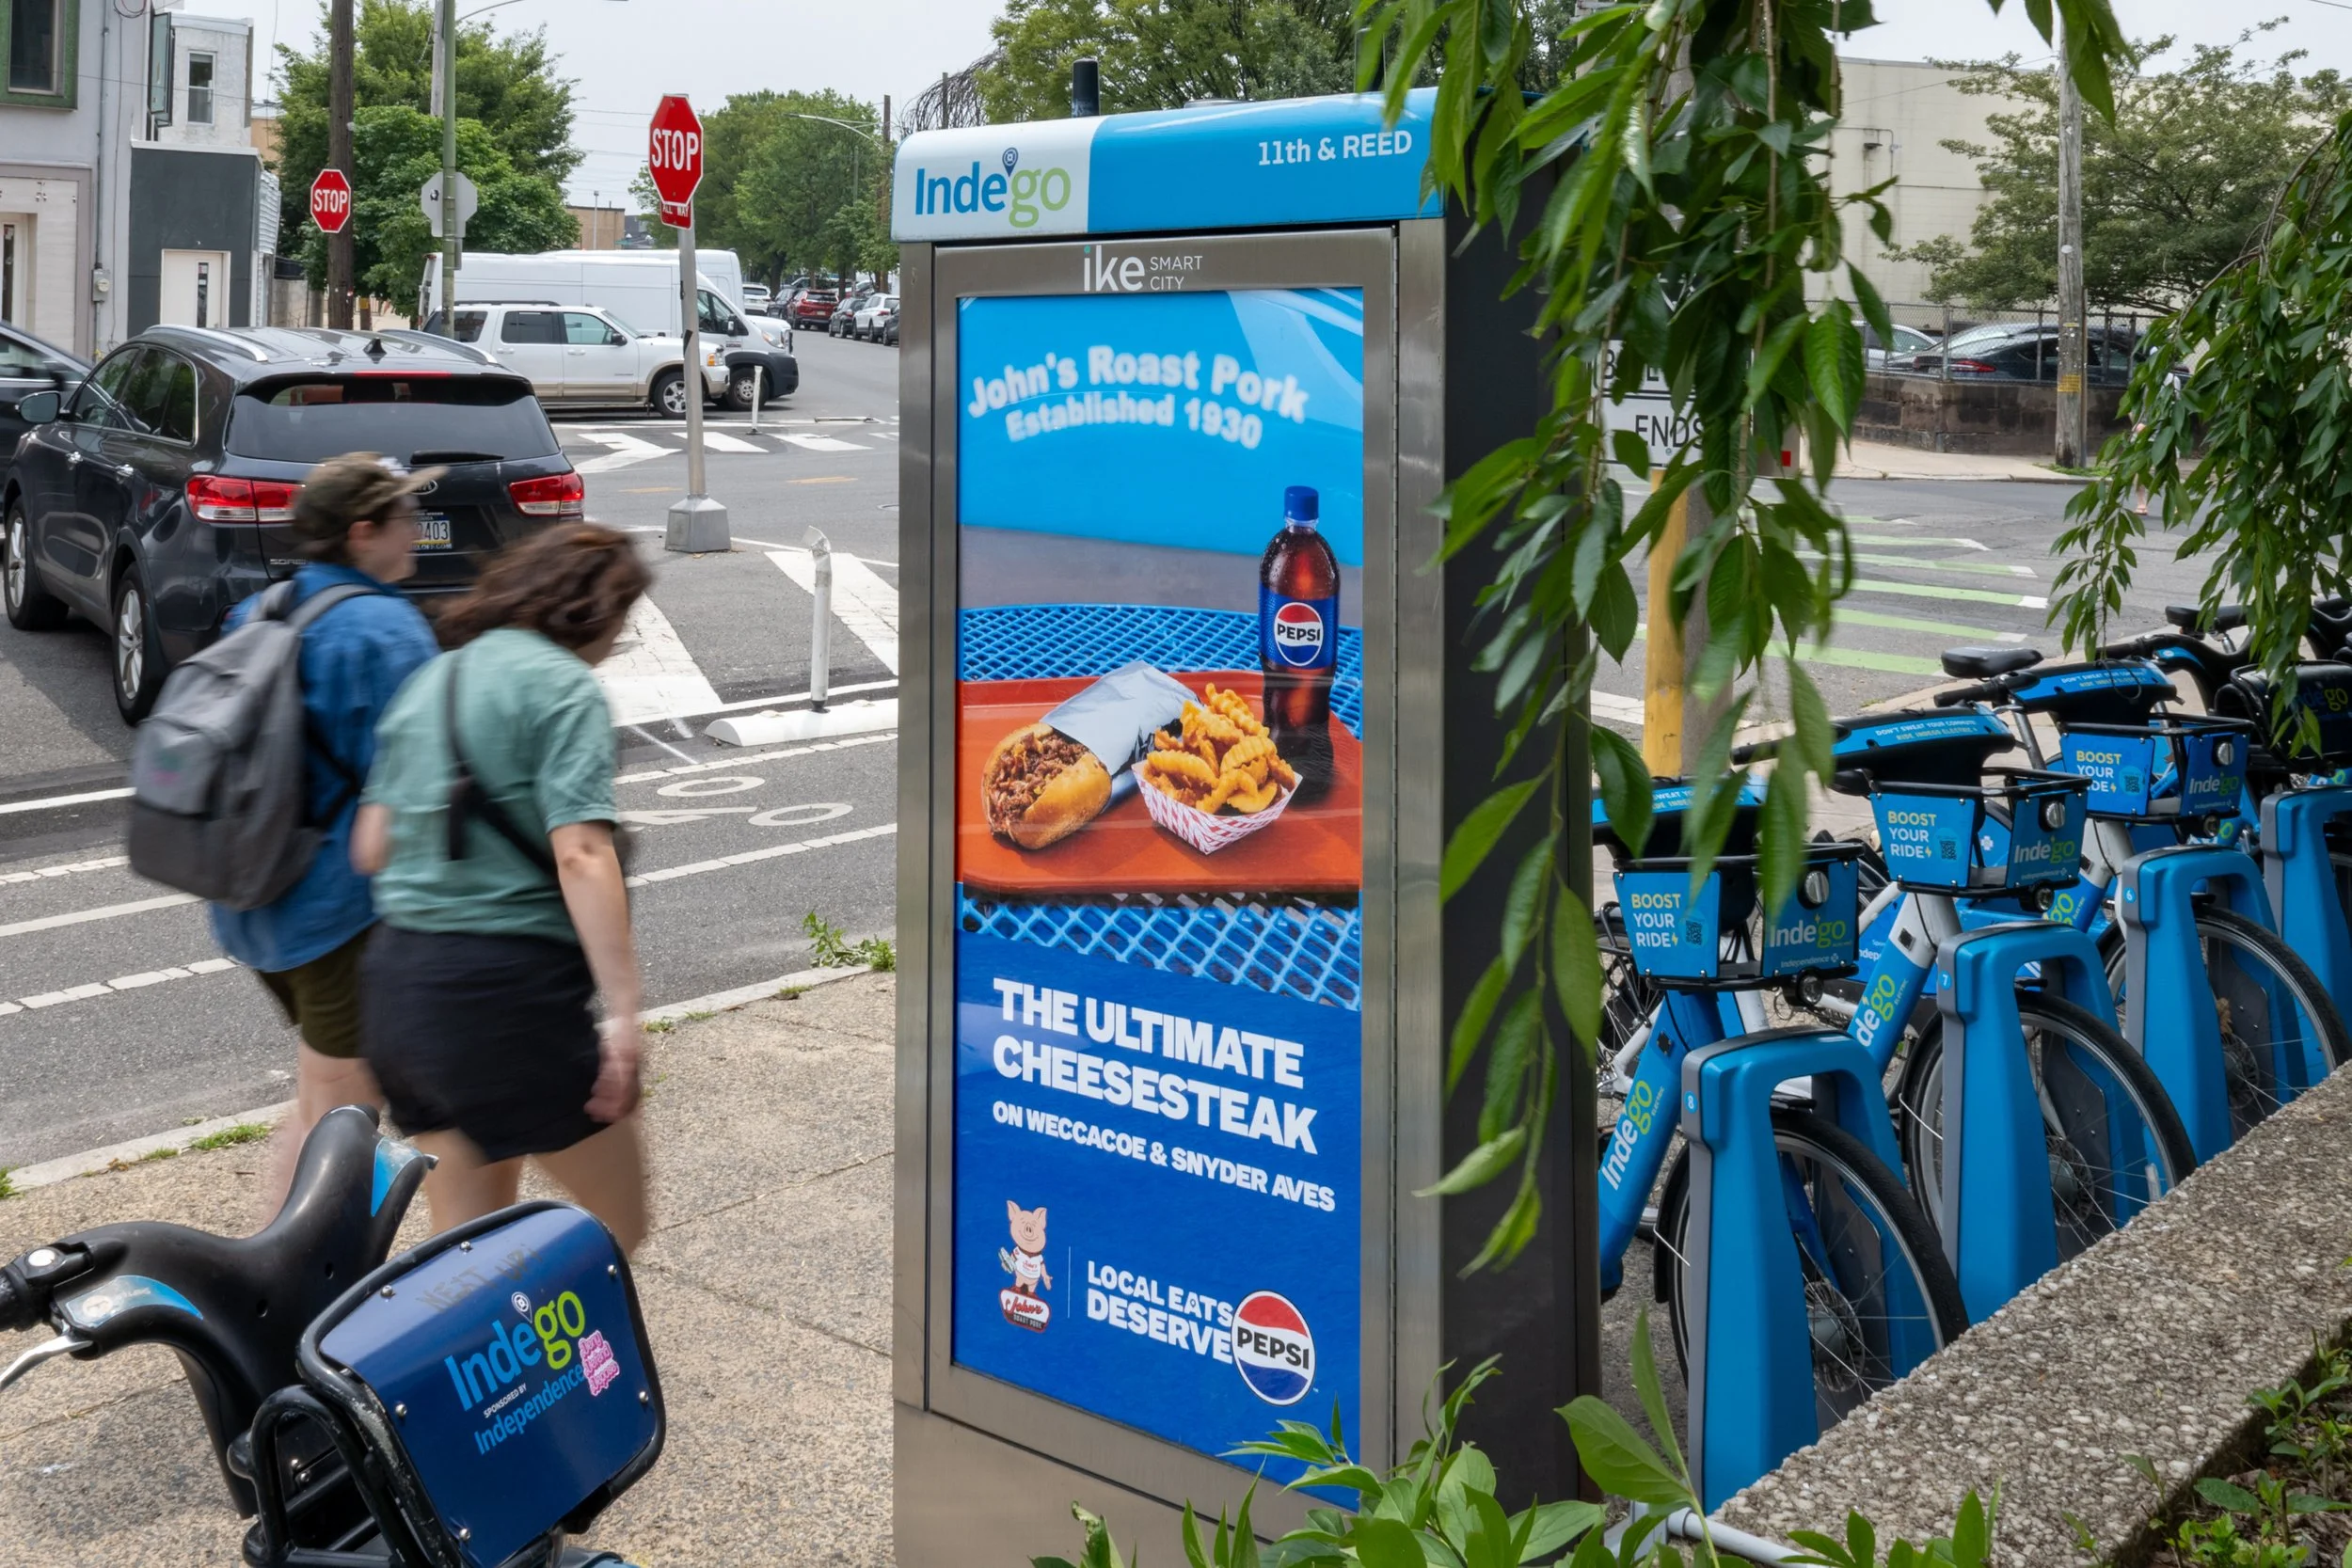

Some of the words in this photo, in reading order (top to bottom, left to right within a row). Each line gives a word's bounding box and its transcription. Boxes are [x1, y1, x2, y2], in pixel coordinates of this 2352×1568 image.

[651, 128, 699, 170] STOP
[1258, 138, 1311, 166] 11th
[1317, 137, 1337, 161] &
[1343, 130, 1413, 159] REED
[313, 189, 348, 213] STOP
[914, 160, 1072, 229] Indego
[662, 205, 674, 214] ALL
[676, 206, 690, 217] WAY
[1084, 244, 1146, 292] ike
[1150, 255, 1203, 271] SMART
[1150, 277, 1184, 291] CITY
[968, 352, 1079, 418] John's
[1088, 344, 1201, 390] Roast
[1211, 353, 1310, 423] Pork
[1005, 390, 1175, 442] Established
[1184, 397, 1263, 450] 1930
[1635, 414, 1704, 450] ENDS
[1277, 623, 1321, 641] PEPSI
[2076, 750, 2122, 765] BOOST
[2076, 764, 2114, 779] YOUR
[2087, 780, 2109, 792] DE
[1887, 810, 1937, 827] BOOST
[1888, 827, 1930, 843] YOUR
[1890, 844, 1925, 859] RIDE
[2013, 839, 2075, 863] Indego
[1630, 893, 1681, 910] BOOST
[2126, 890, 2133, 901] 6
[1633, 912, 1675, 928] YOUR
[1769, 919, 1846, 949] Indego
[1636, 932, 1671, 948] RIDE
[1942, 974, 1948, 987] 7
[1854, 974, 1896, 1047] dego
[993, 977, 1078, 1036] THE
[1085, 997, 1304, 1089] ULTIMATE
[993, 1034, 1318, 1155] CHEESESTEAK
[1687, 1095, 1694, 1110] 8
[1600, 1079, 1653, 1192] Indego
[993, 1101, 1024, 1128] ON
[1026, 1108, 1147, 1161] WECCACOE
[1150, 1141, 1168, 1167] &
[1170, 1147, 1268, 1194] SNYDER
[1272, 1173, 1336, 1212] AVES
[1088, 1260, 1165, 1307] LOCAL
[1168, 1285, 1234, 1327] EATS
[1087, 1288, 1233, 1365] DESERVE
[444, 1290, 586, 1412] Indego
[1236, 1325, 1310, 1370] PEPSI
[474, 1364, 586, 1455] Independence
[484, 1387, 518, 1419] SPONSORED
[517, 1383, 528, 1397] BY
